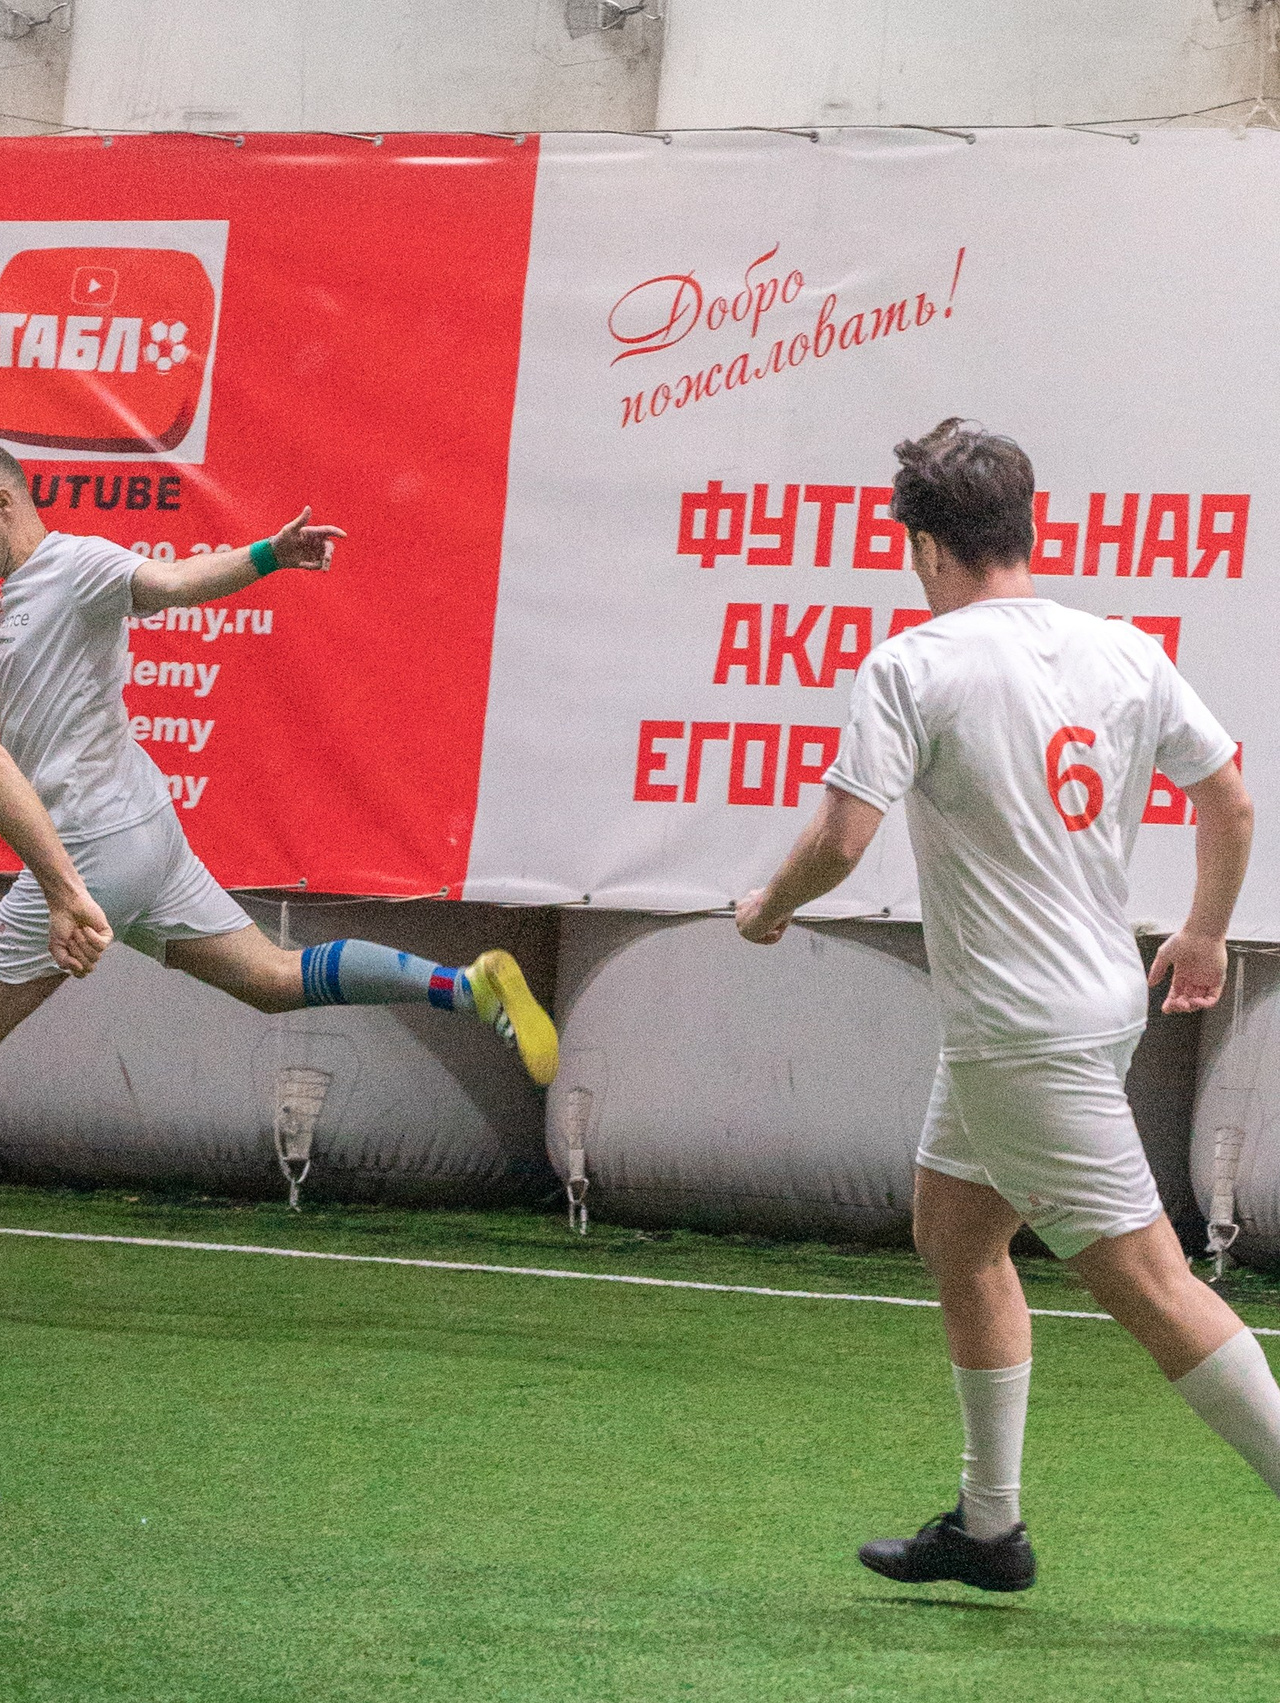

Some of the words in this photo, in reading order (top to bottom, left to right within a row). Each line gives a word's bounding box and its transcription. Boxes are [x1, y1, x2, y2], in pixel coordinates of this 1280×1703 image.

[608, 242, 805, 367] Добро
[620, 247, 966, 429] пожаловать!
[31, 474, 181, 511] UTUBE
[677, 480, 1251, 579] ФУТБЬНАЯ
[633, 719, 843, 808] ЕГОР
[1045, 725, 1105, 832] 6
